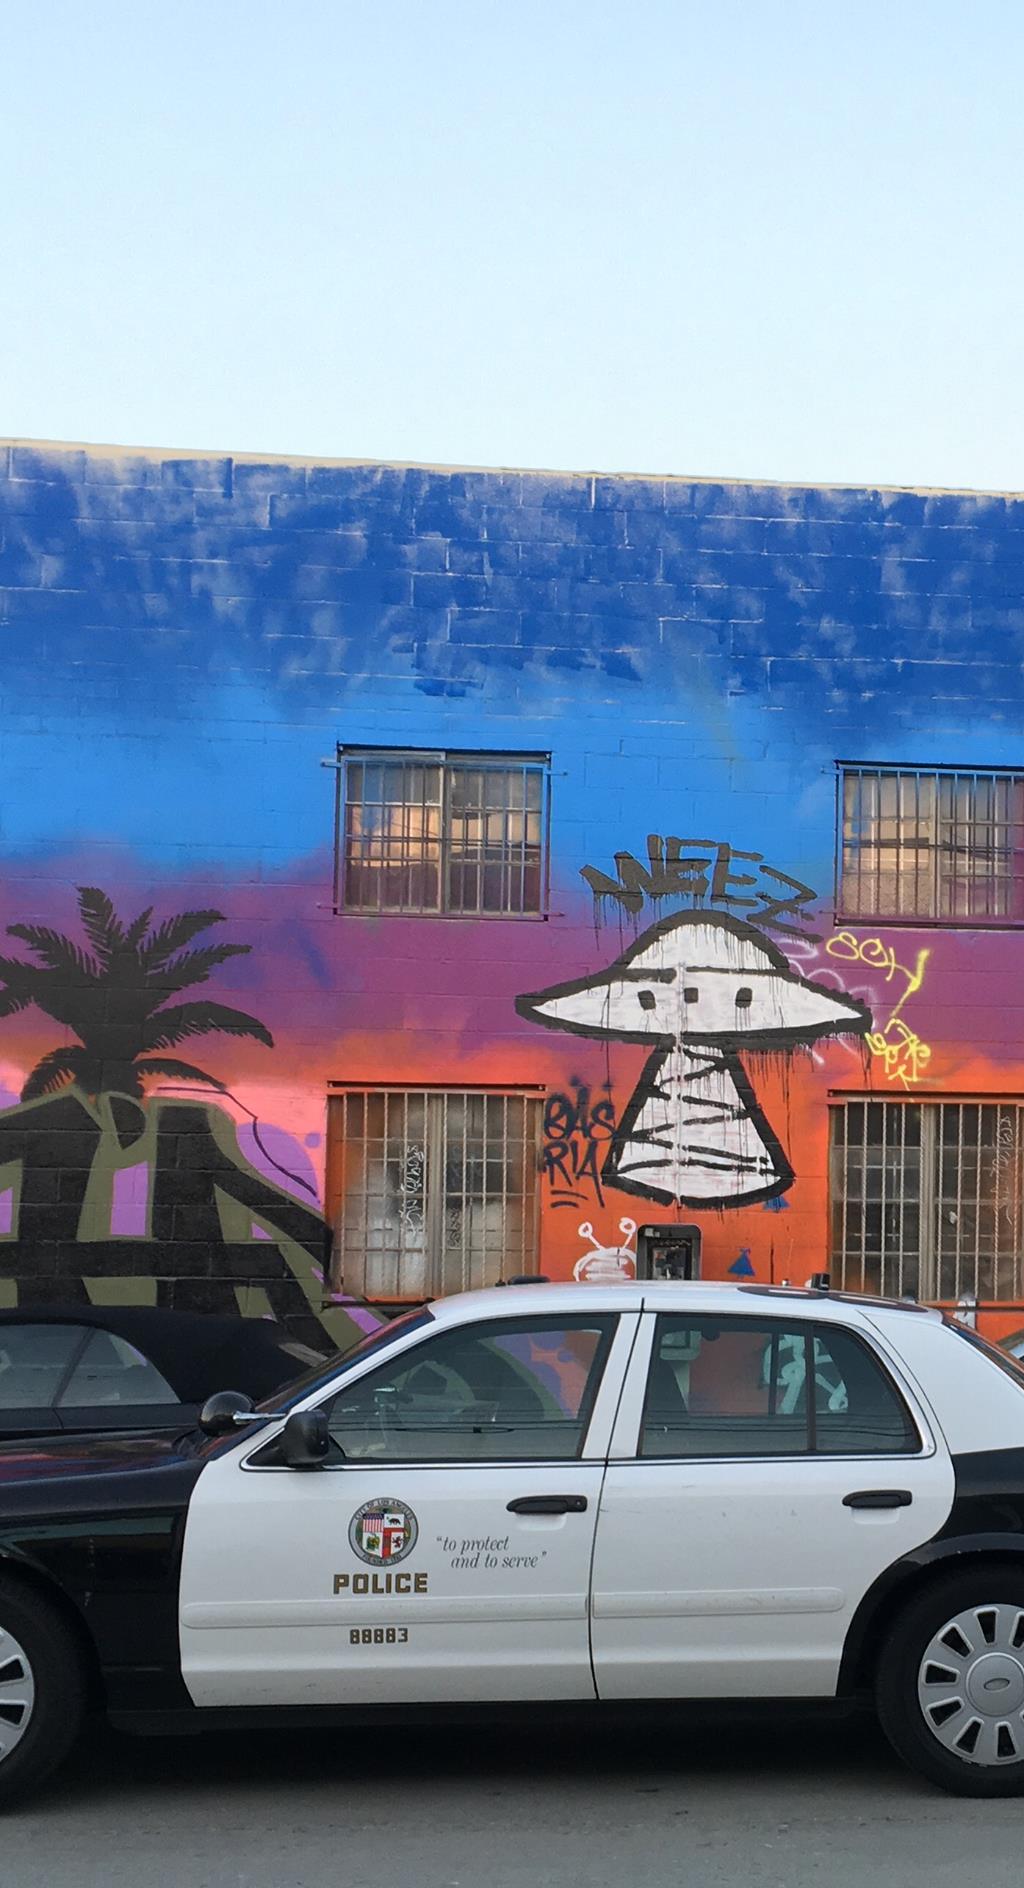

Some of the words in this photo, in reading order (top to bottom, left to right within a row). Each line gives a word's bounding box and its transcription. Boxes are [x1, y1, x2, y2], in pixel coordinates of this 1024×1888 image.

[460, 1536, 510, 1555] protect
[451, 1553, 478, 1568] and
[484, 1553, 498, 1568] to
[333, 1573, 428, 1594] POLICE
[350, 1628, 408, 1644] 88883
